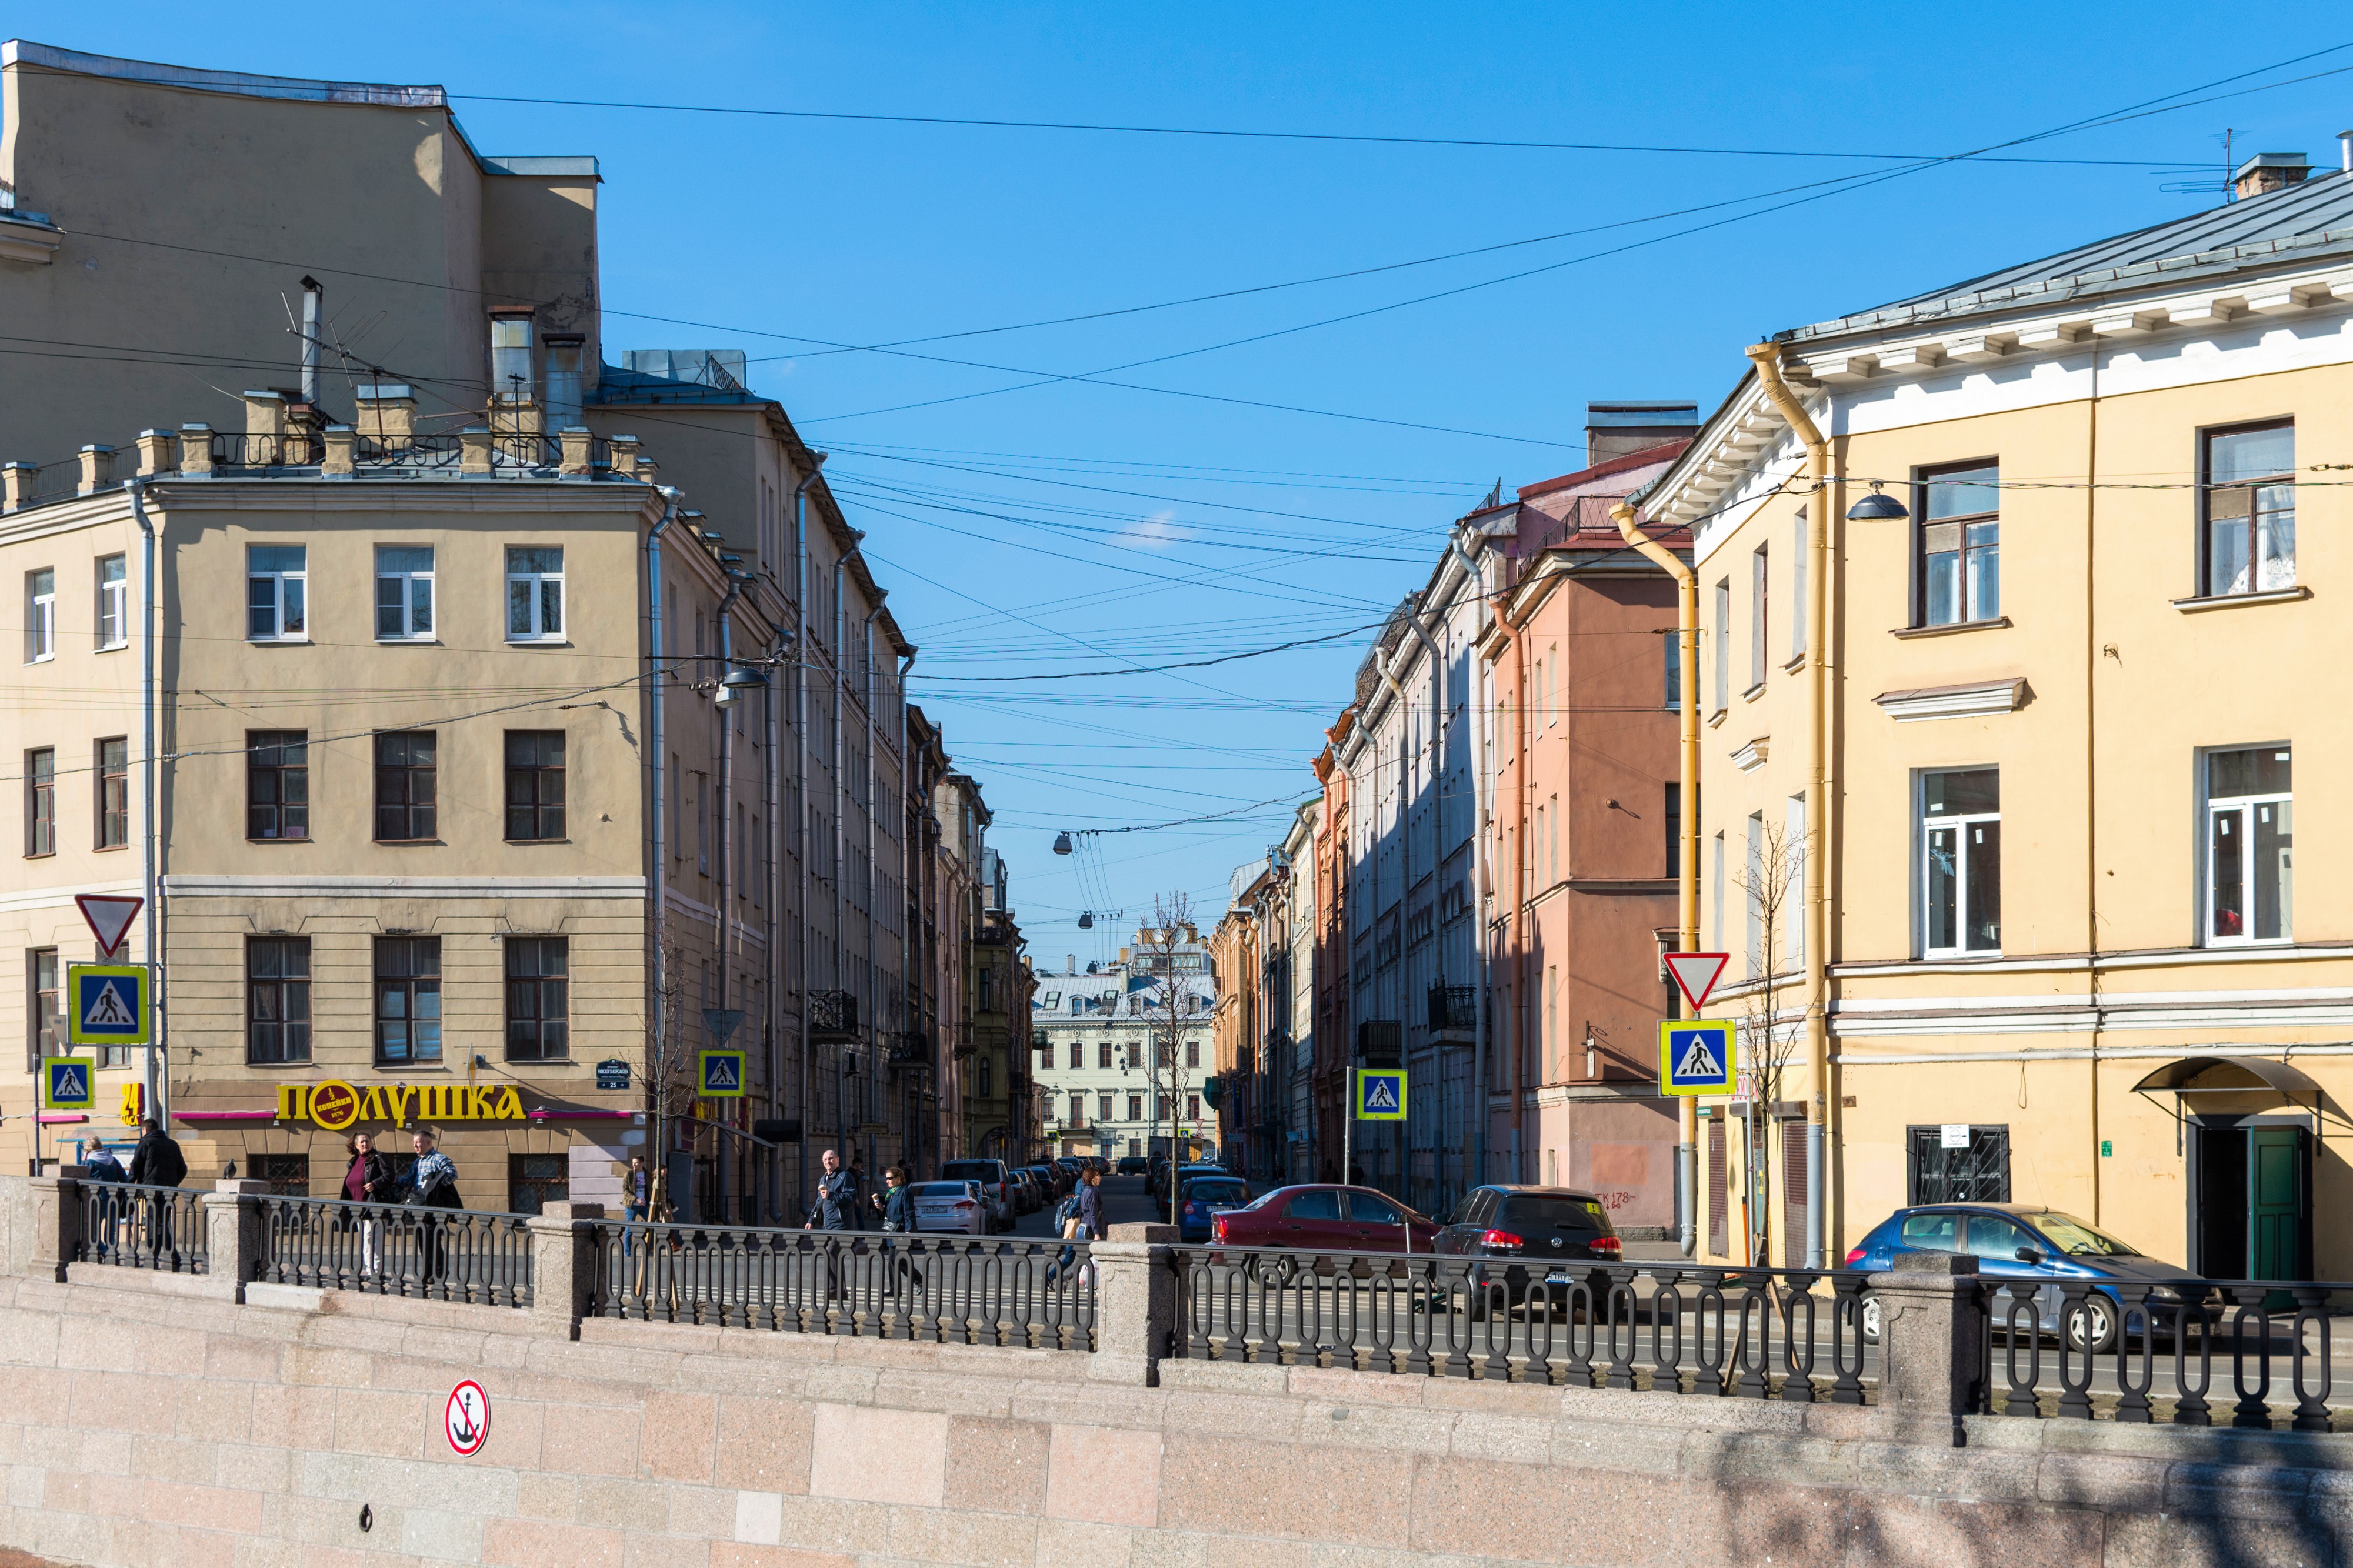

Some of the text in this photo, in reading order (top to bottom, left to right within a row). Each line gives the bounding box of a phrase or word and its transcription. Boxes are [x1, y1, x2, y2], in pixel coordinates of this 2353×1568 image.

[120, 1083, 139, 1116] 24
[276, 1080, 526, 1130] ПОЛУШКА
[316, 1096, 352, 1113] КОПЕЙКИ
[121, 1116, 139, 1126] ЧАСА
[331, 1110, 344, 1119] 1870
